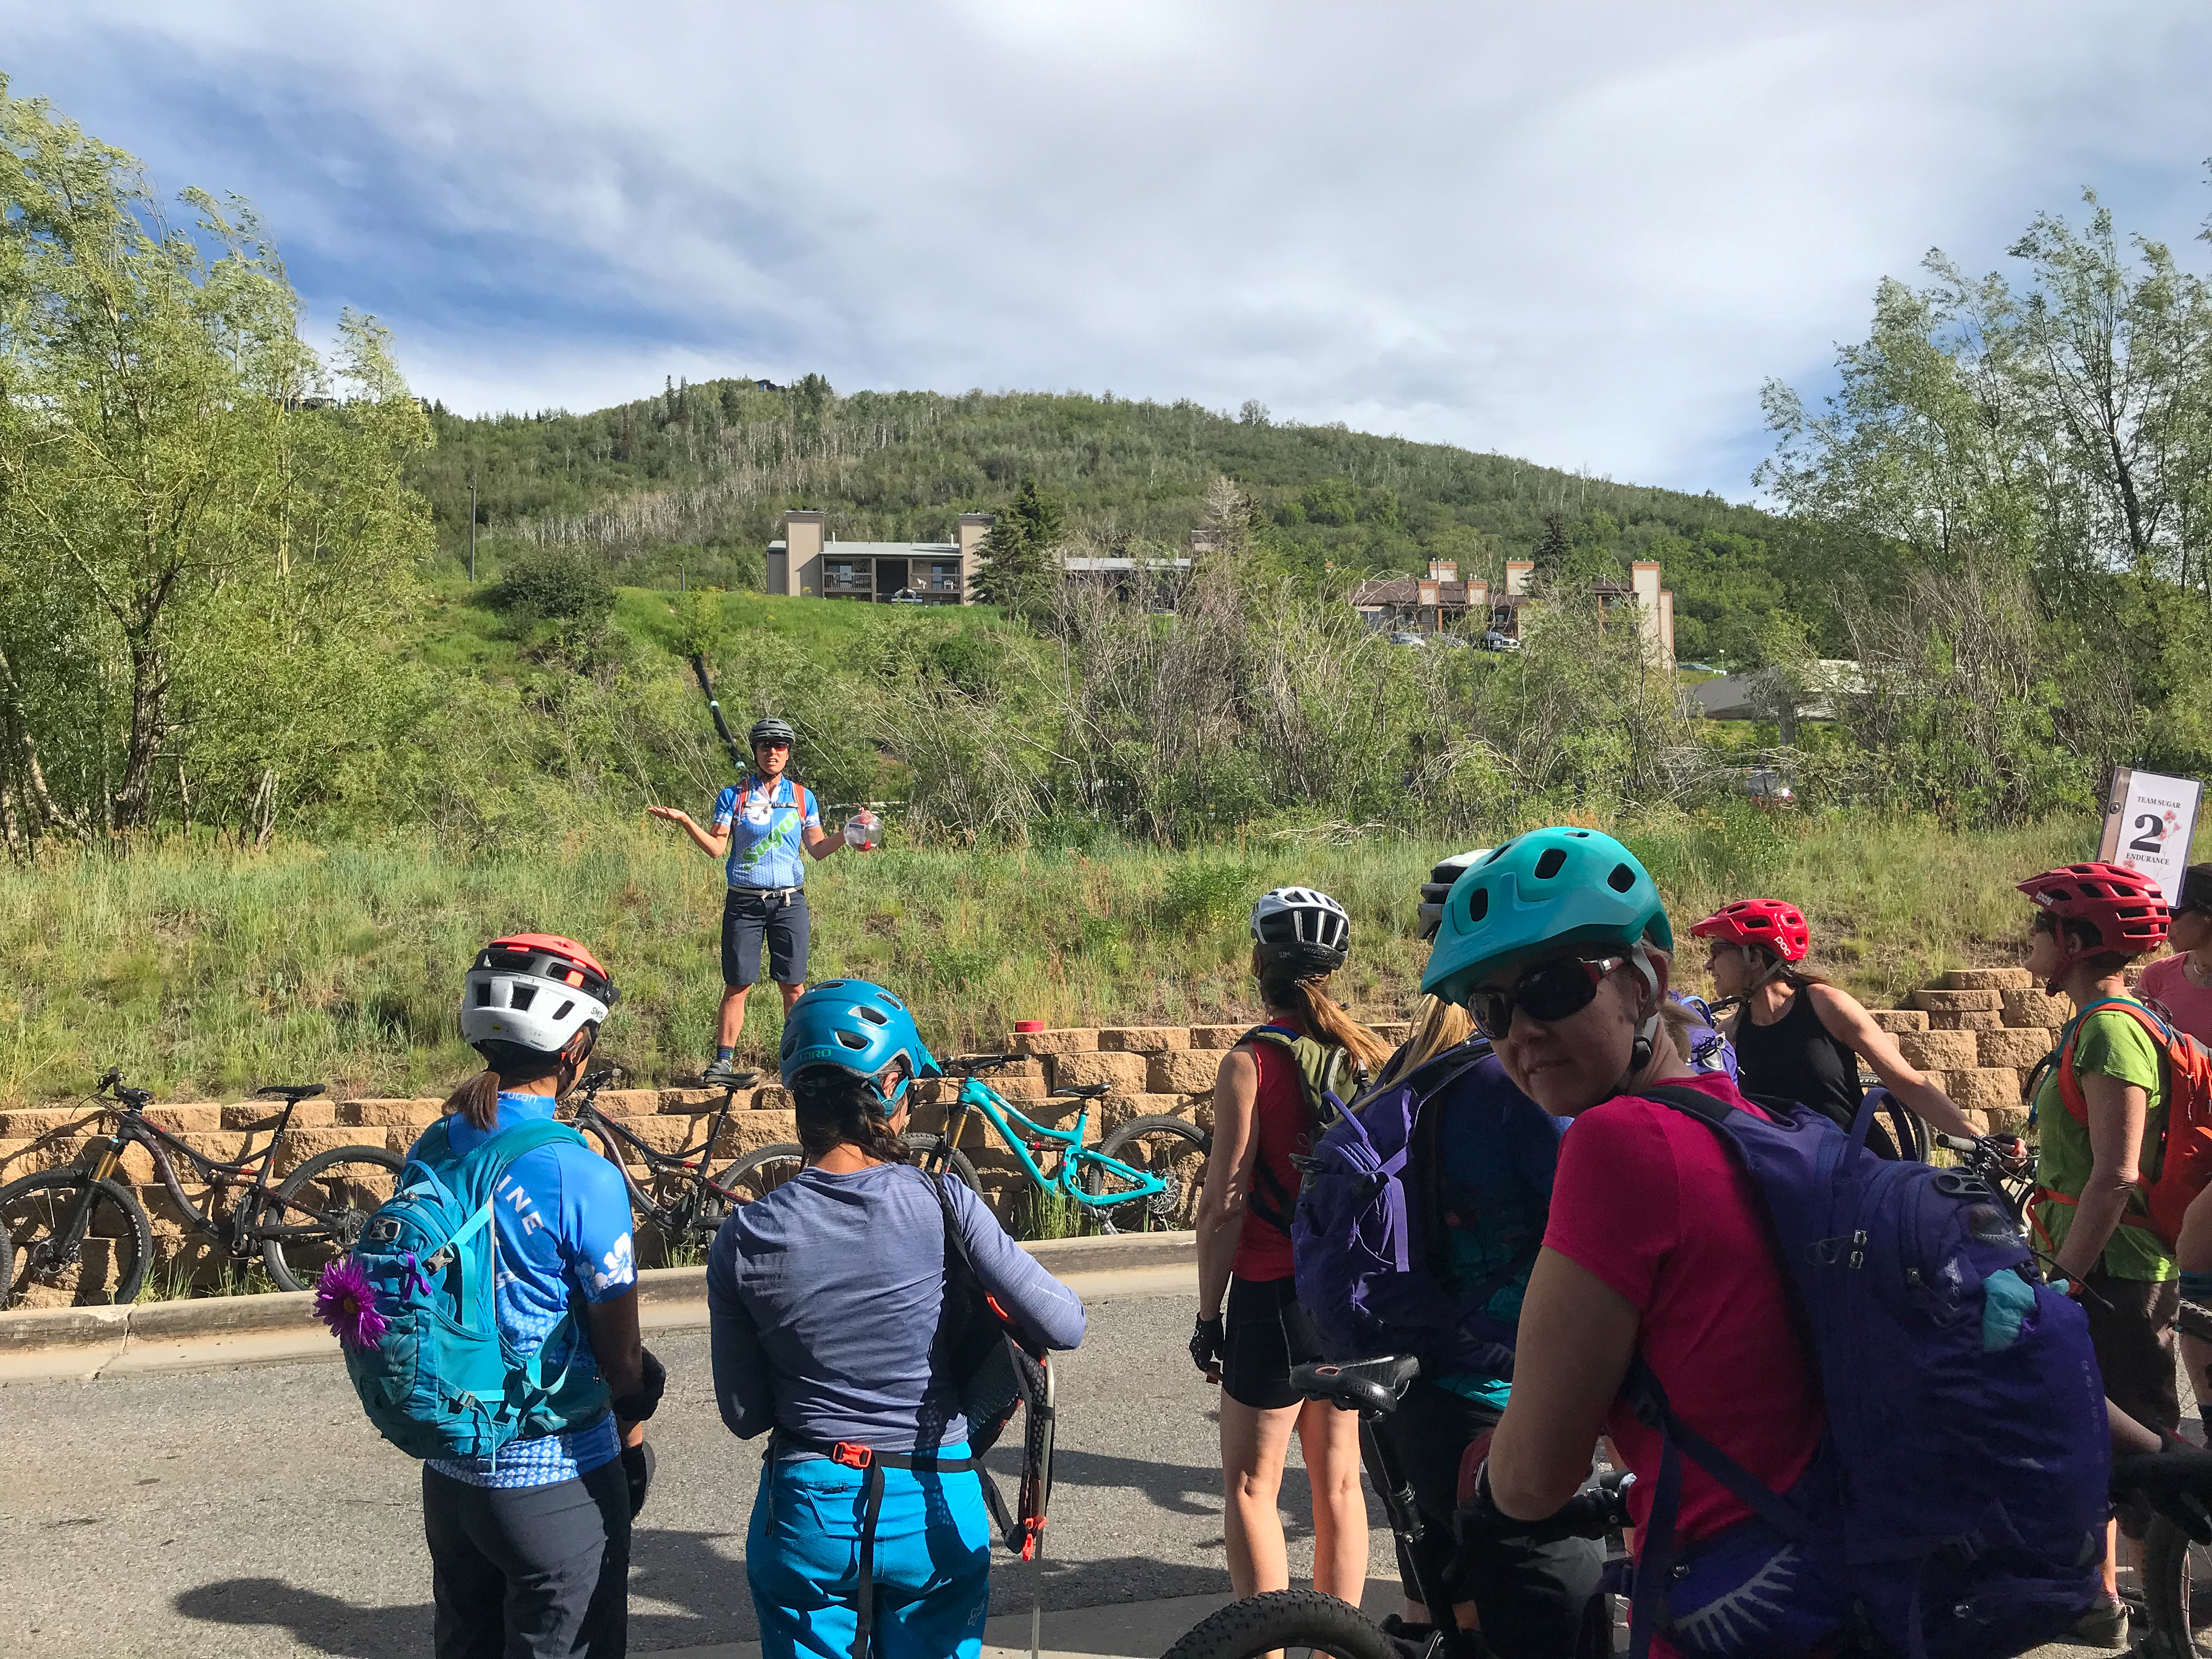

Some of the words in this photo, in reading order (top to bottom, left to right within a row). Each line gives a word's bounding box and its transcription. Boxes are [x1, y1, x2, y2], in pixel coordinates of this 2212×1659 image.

[2137, 796, 2157, 805] TEAM
[2158, 799, 2181, 809] SUGAR
[742, 810, 799, 871] Sugar
[2129, 814, 2164, 854] 2
[2126, 853, 2170, 866] ENDURANCE
[591, 1006, 603, 1020] SMITH
[800, 1048, 832, 1060] GIRO
[130, 1215, 142, 1257] MAXXIS
